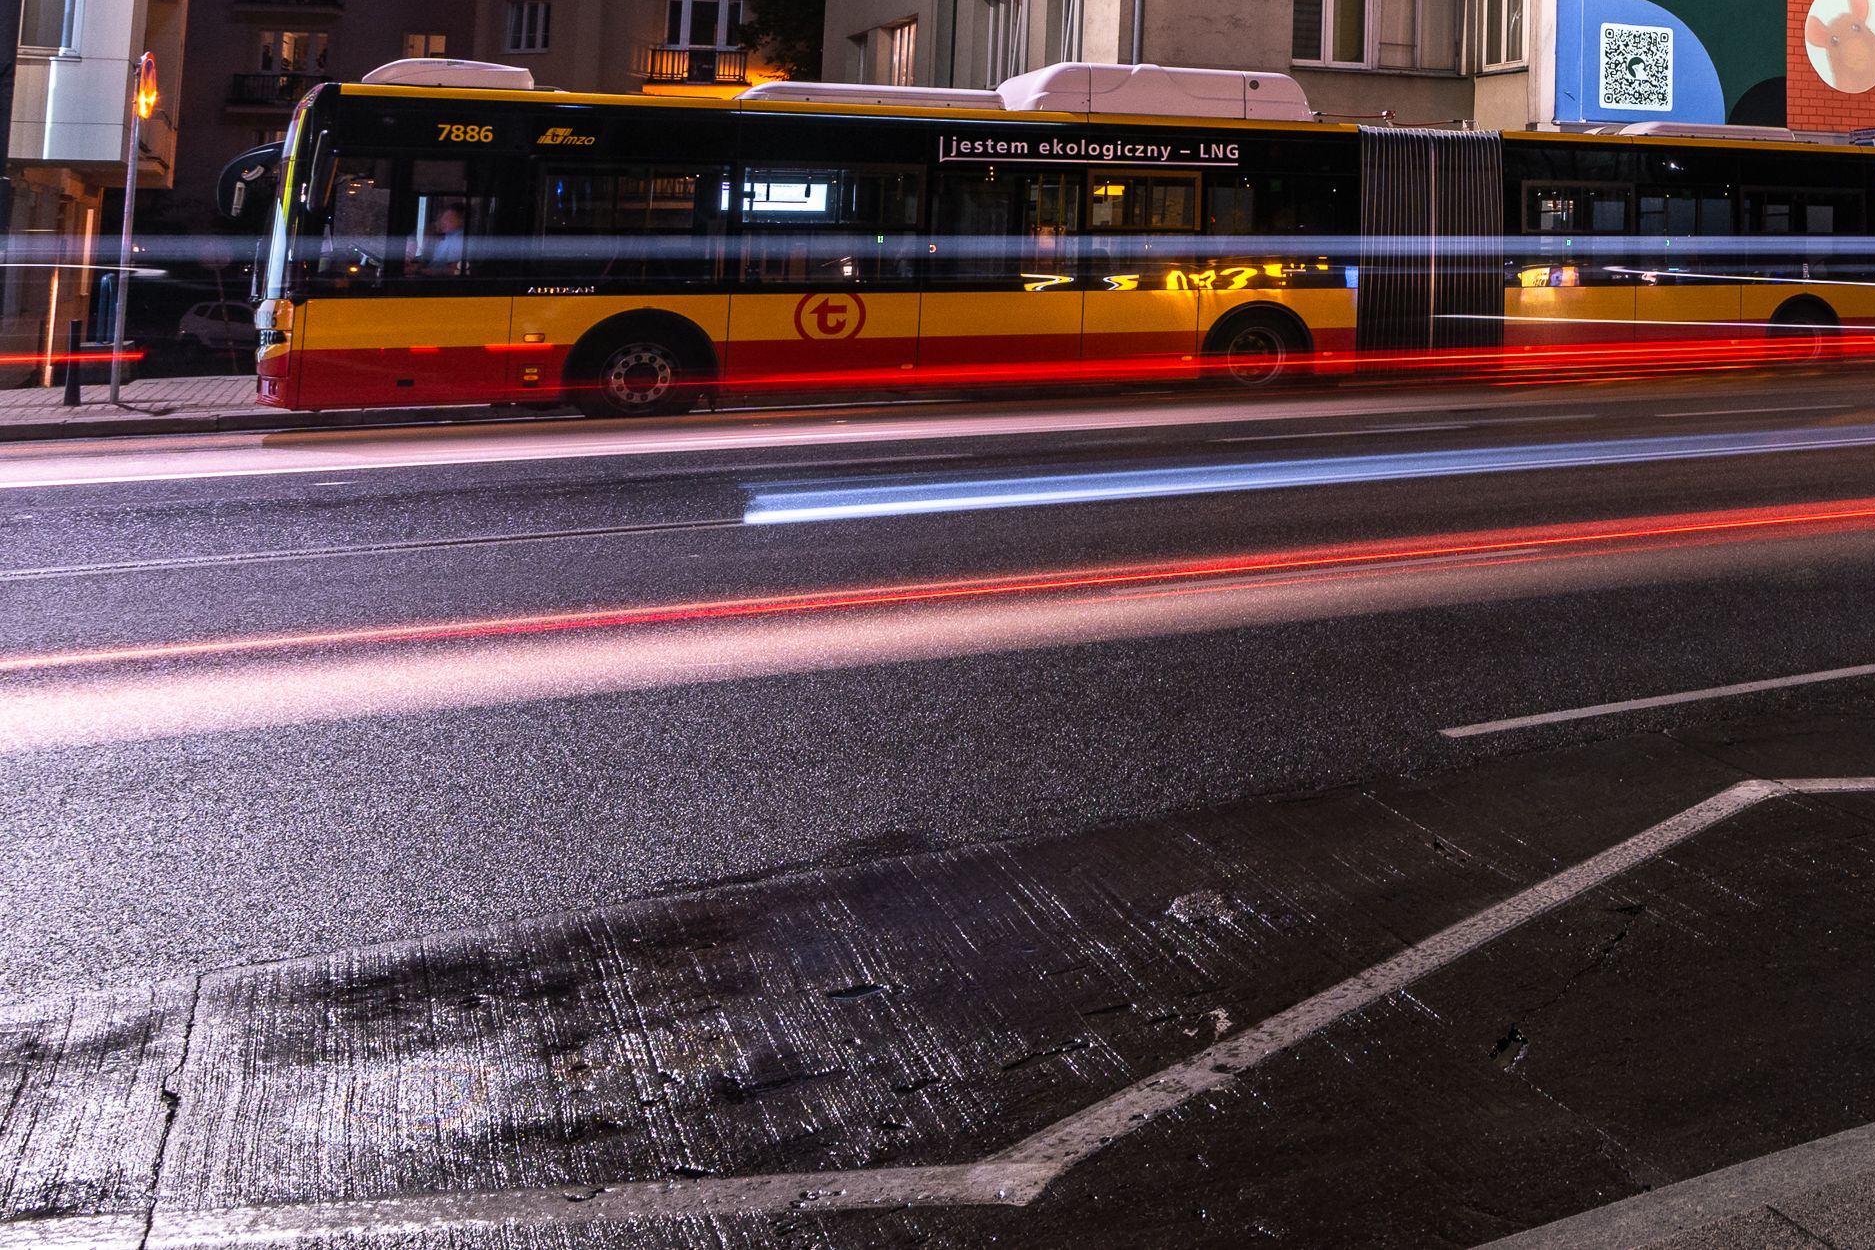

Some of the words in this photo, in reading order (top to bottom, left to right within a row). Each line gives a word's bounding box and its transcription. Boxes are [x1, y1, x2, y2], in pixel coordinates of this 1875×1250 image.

[437, 123, 494, 143] 7886
[950, 136, 1029, 157] jestem
[1038, 138, 1172, 161] ekologiczny
[1199, 142, 1240, 160] LNG
